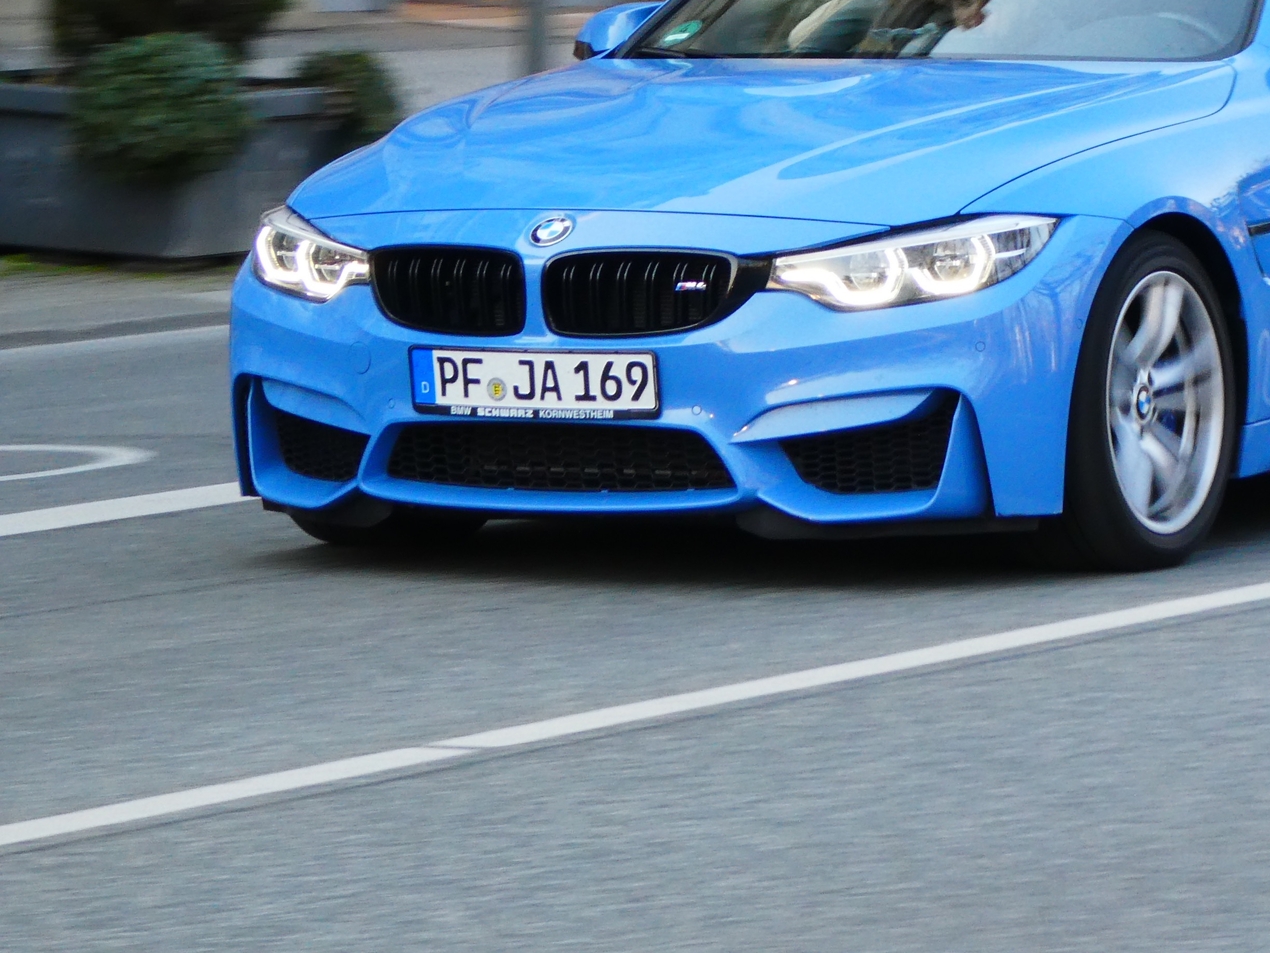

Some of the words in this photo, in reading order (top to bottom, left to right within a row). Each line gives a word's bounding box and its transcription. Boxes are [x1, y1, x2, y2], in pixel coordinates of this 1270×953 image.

[436, 356, 483, 398] PF
[513, 359, 562, 401] JA
[574, 360, 649, 402] 169
[421, 381, 430, 393] D
[450, 406, 472, 416] BMW
[476, 407, 534, 418] SCHWARZ
[539, 409, 614, 419] KORNWESTHEIM
